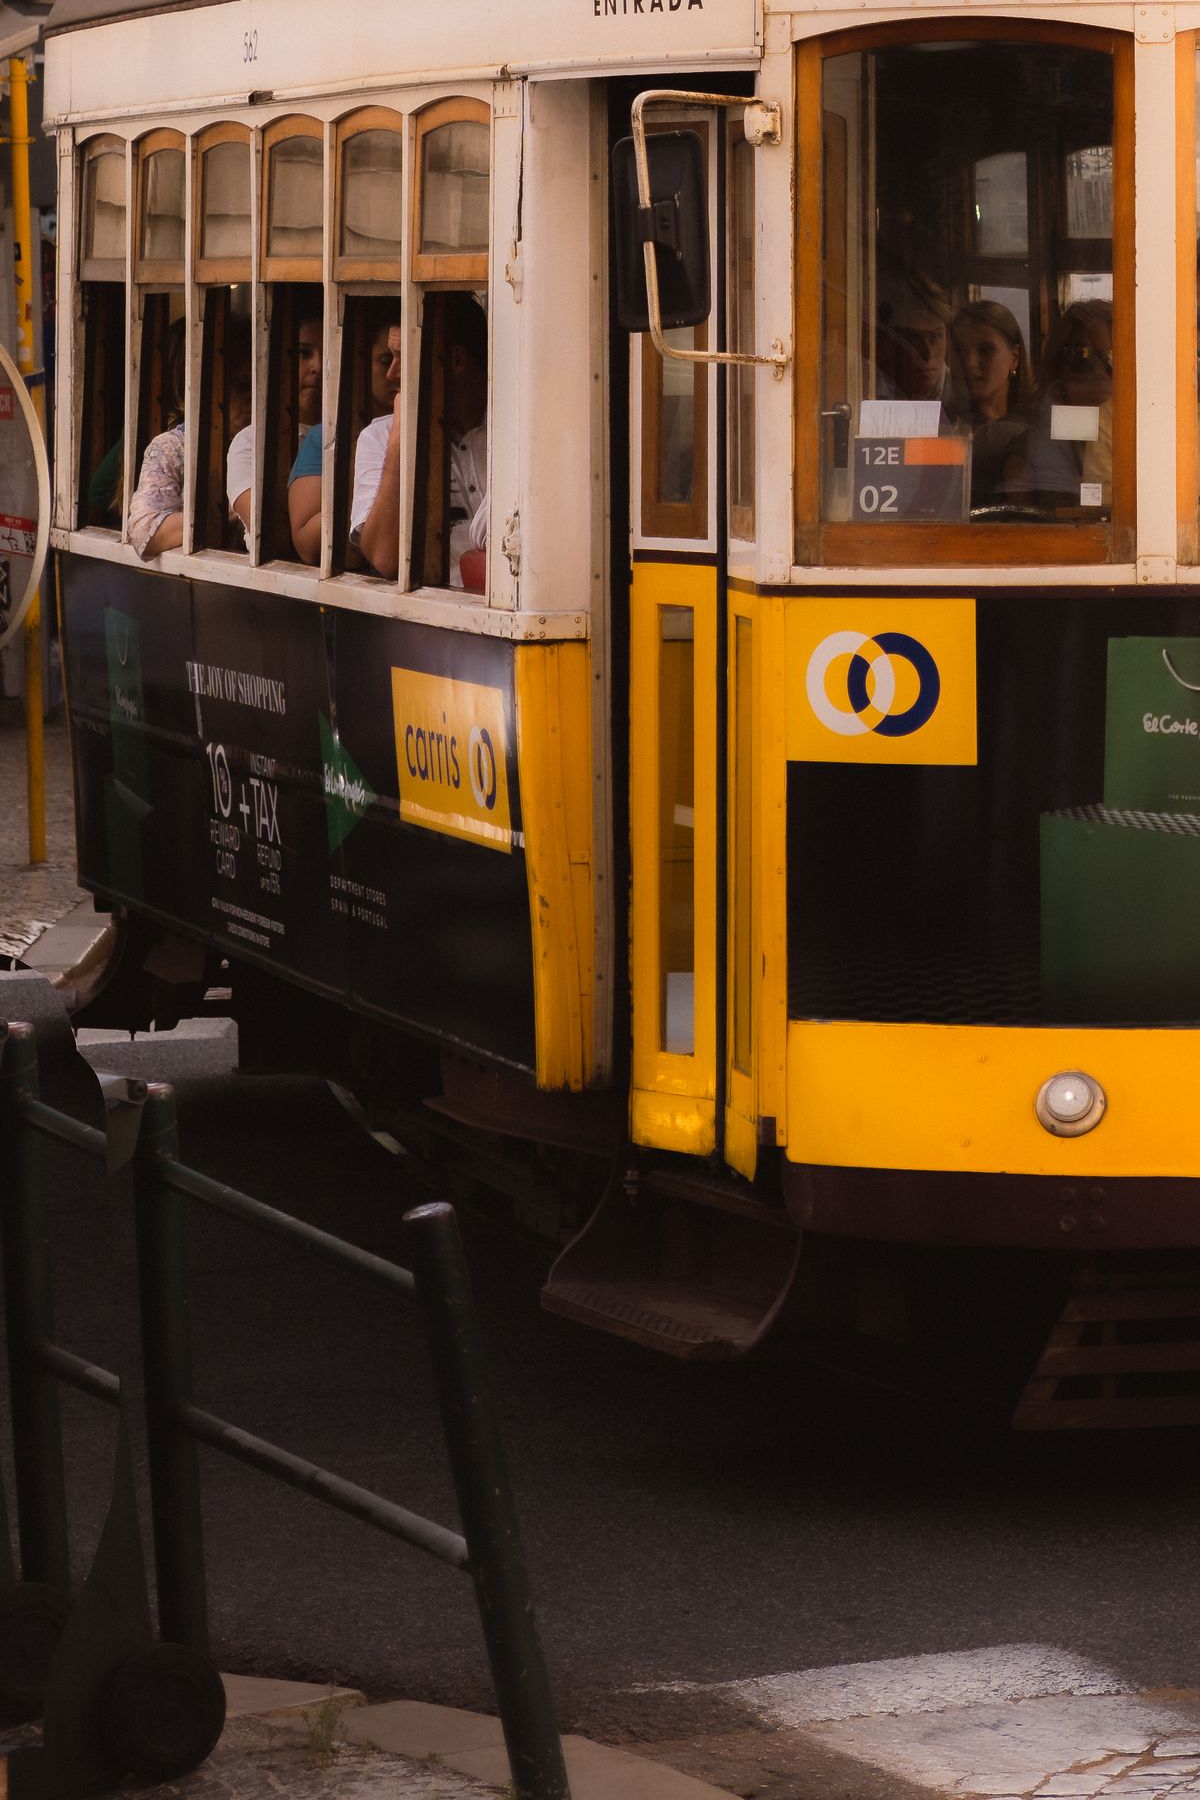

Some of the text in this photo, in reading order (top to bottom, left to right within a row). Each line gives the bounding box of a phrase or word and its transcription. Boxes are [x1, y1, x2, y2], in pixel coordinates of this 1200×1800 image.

[243, 29, 258, 64] 562
[860, 446, 900, 466] 12E
[859, 485, 899, 513] 02
[185, 661, 286, 715] THE JOY OF SHOPPING
[1142, 713, 1159, 733] El
[1159, 714, 1199, 736] Corte
[250, 753, 277, 778] INSTANT
[404, 711, 461, 790] carris
[210, 817, 241, 852] REWARD
[216, 849, 236, 880] CARD
[257, 843, 282, 872] REFUND
